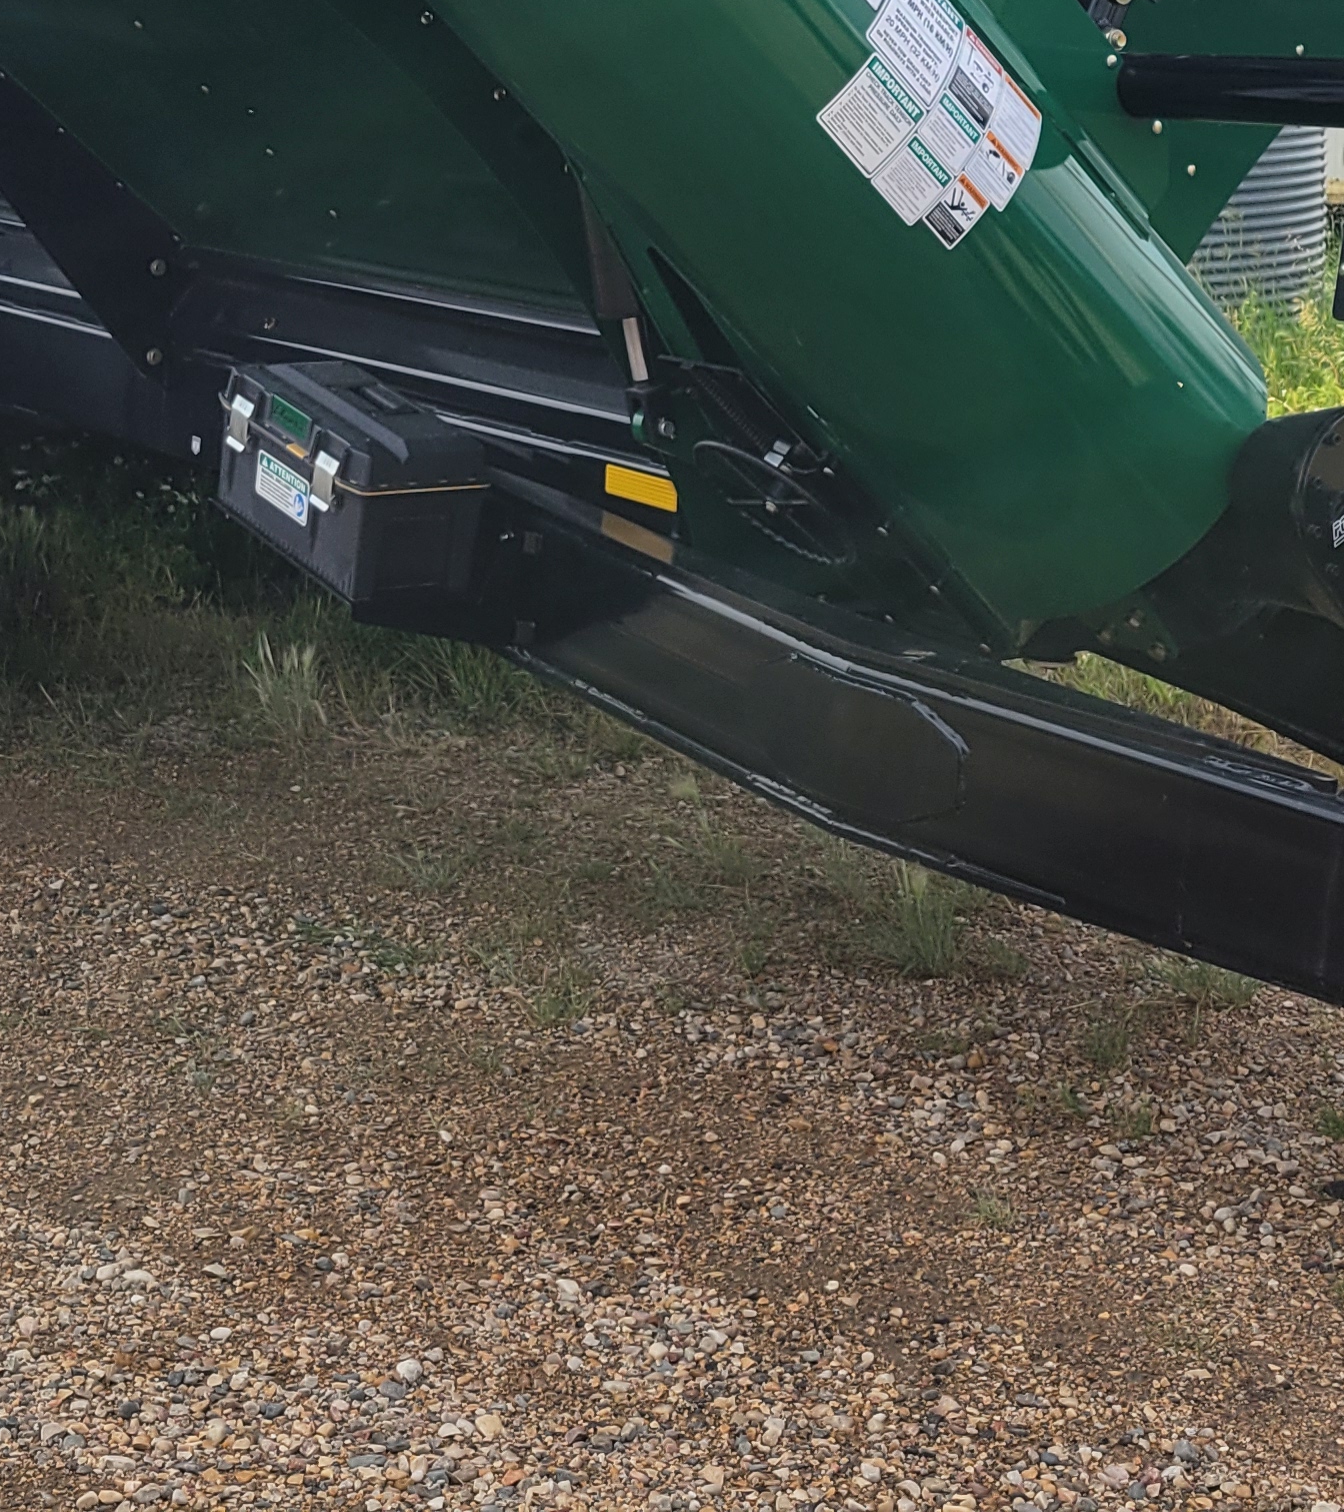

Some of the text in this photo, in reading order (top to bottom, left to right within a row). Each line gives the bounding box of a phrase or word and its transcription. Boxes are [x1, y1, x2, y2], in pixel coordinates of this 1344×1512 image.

[885, 14, 896, 27] 20
[894, 26, 911, 45] MPH
[872, 61, 921, 118] IMPORTANT
[942, 97, 979, 139] IMPORTANT
[911, 140, 949, 183] IMPORTANT
[270, 462, 305, 493] ATTENTION
